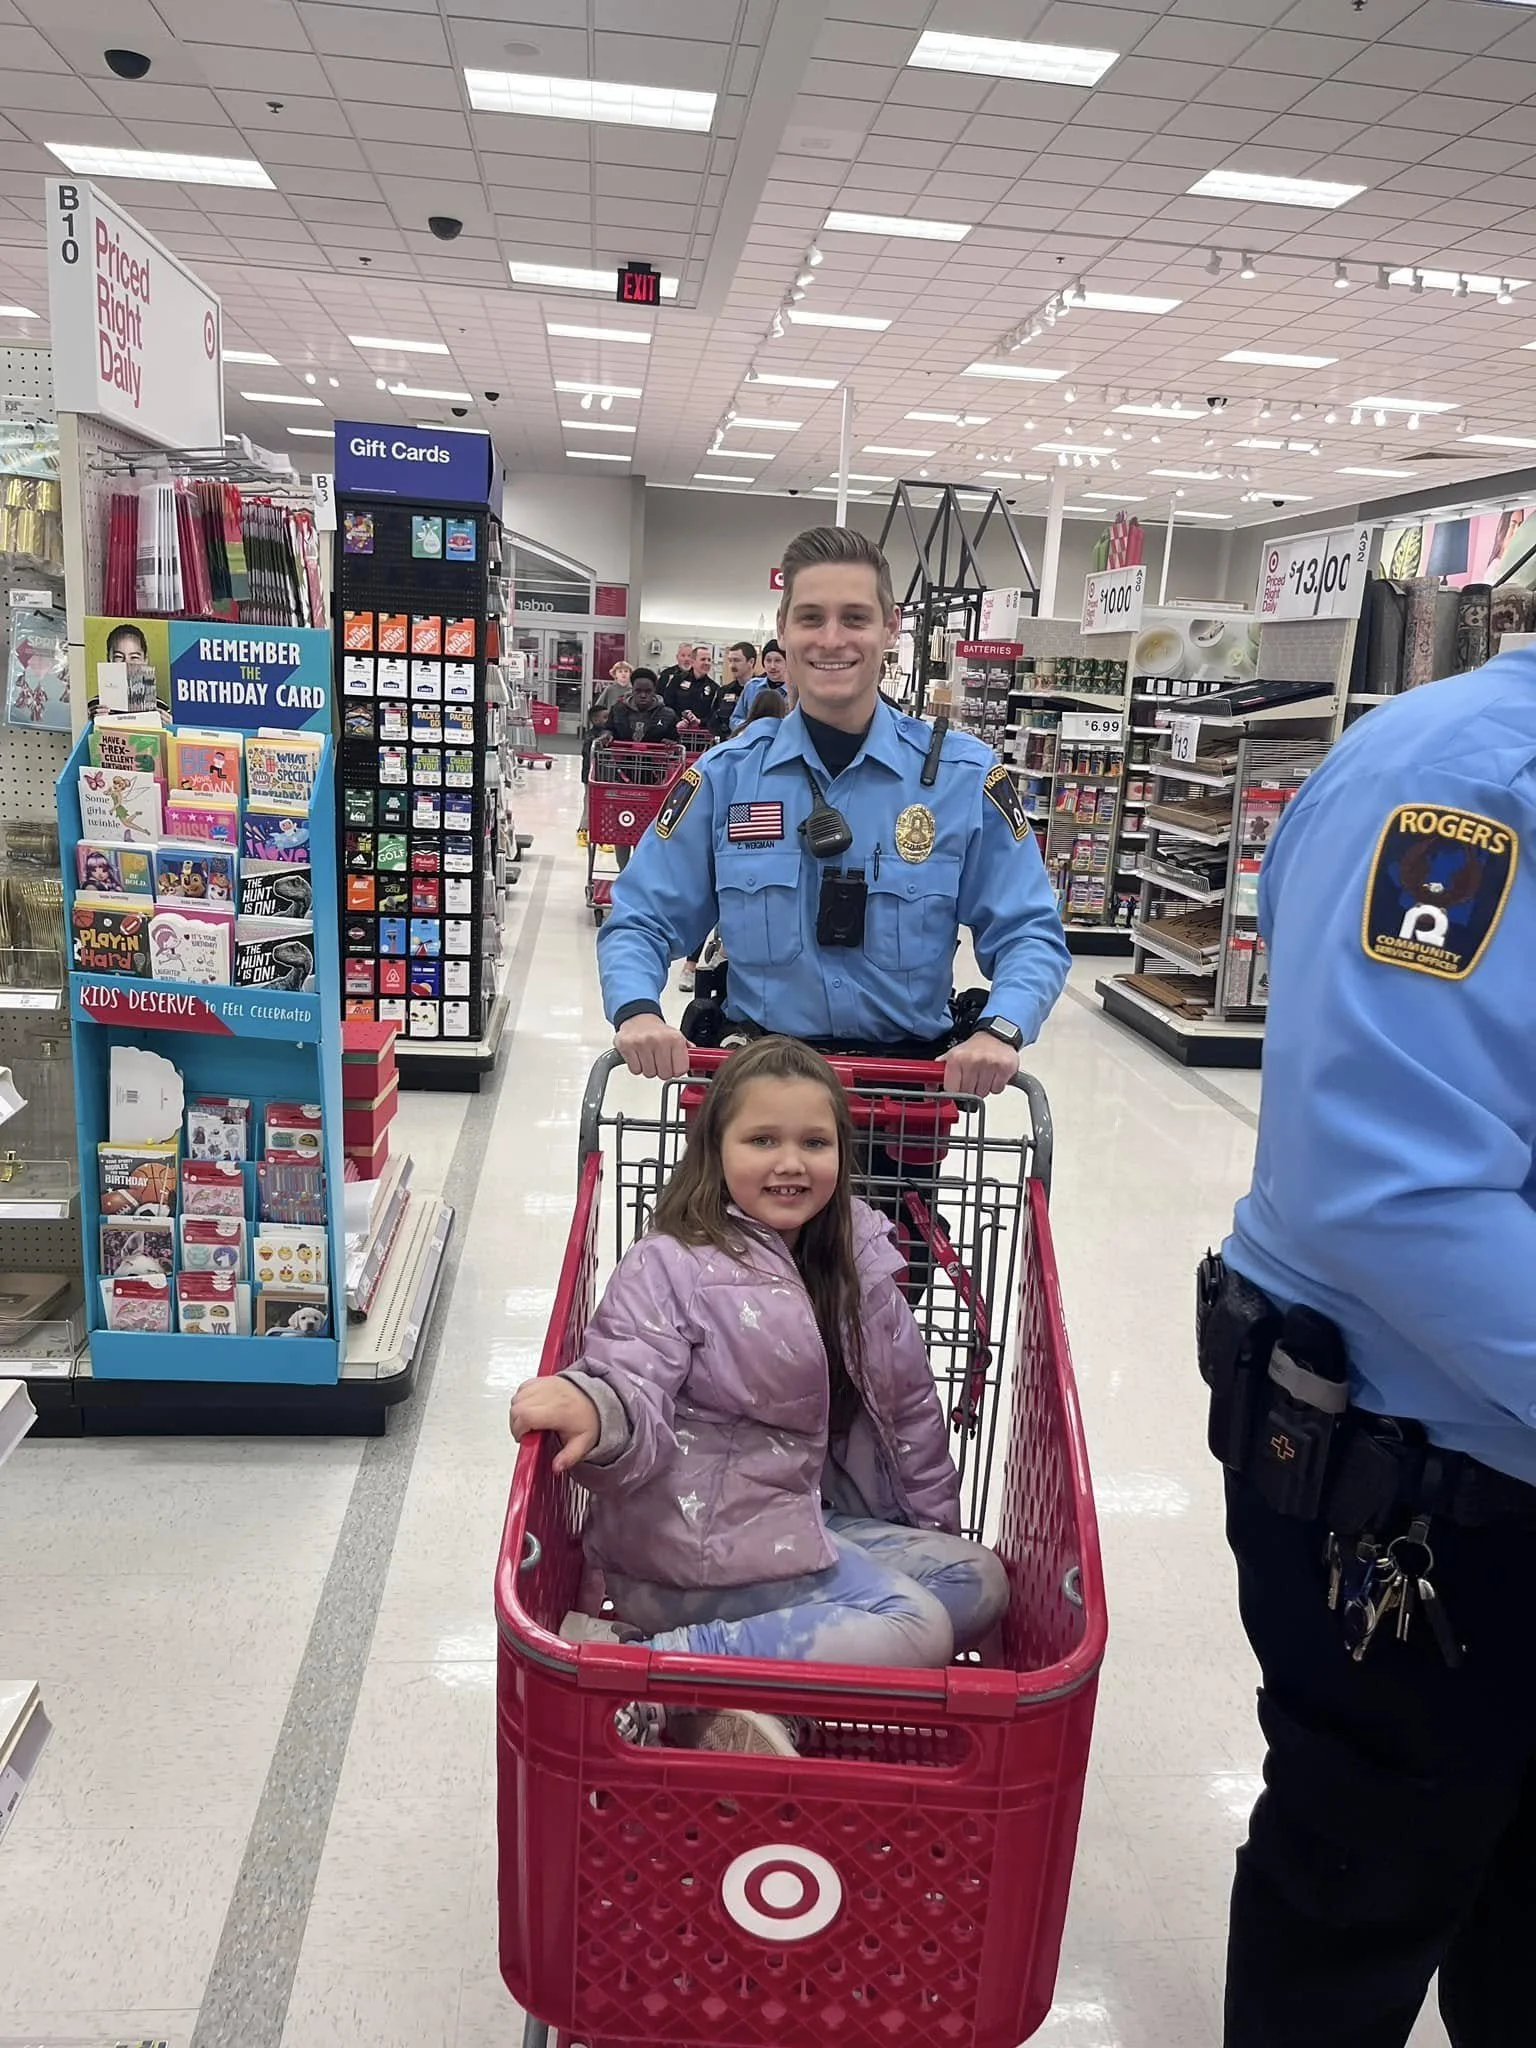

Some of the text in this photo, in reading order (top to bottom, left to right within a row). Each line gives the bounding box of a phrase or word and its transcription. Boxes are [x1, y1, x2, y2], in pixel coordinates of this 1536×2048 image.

[96, 217, 150, 304] Priced
[623, 272, 657, 302] EXIT
[97, 273, 143, 351] Right
[99, 328, 142, 409] Daily
[350, 438, 451, 464] Gift Cards
[1357, 530, 1369, 562] A32
[1265, 574, 1287, 587] Priced
[1263, 587, 1281, 601] Right
[1261, 600, 1279, 614] Daily
[199, 637, 301, 666] REMEMBER
[962, 644, 1012, 656] BATTERIES
[240, 665, 262, 681] THE
[177, 678, 326, 710] BIRTHDAY CARD
[1084, 719, 1120, 732] $6.99
[102, 735, 120, 745] HAVE
[104, 754, 135, 763] CELLENT
[181, 748, 210, 777] BE
[276, 752, 308, 765] WHAT
[277, 769, 312, 784] SPECIAL
[201, 782, 236, 793] OWN
[85, 793, 110, 804] Some
[87, 806, 106, 817] girls
[88, 819, 121, 830] twinkle
[1399, 810, 1510, 854] ROGERS
[377, 850, 407, 864] GOLF
[247, 877, 264, 888] THE
[242, 886, 273, 903] HUNT
[243, 899, 277, 916] IS ON!
[246, 943, 263, 955] THE
[1376, 934, 1463, 963] COMMUNITY
[80, 948, 133, 971] Hard
[241, 952, 273, 970] HUNT
[1375, 945, 1459, 972] SERVICE OFFICER
[243, 965, 277, 983] IS ON!
[80, 985, 120, 1009] KIDS
[128, 989, 198, 1016] DESERVE
[205, 1000, 217, 1014] to
[222, 1003, 244, 1018] FEEL
[104, 1174, 149, 1187] BIRTHDAY
